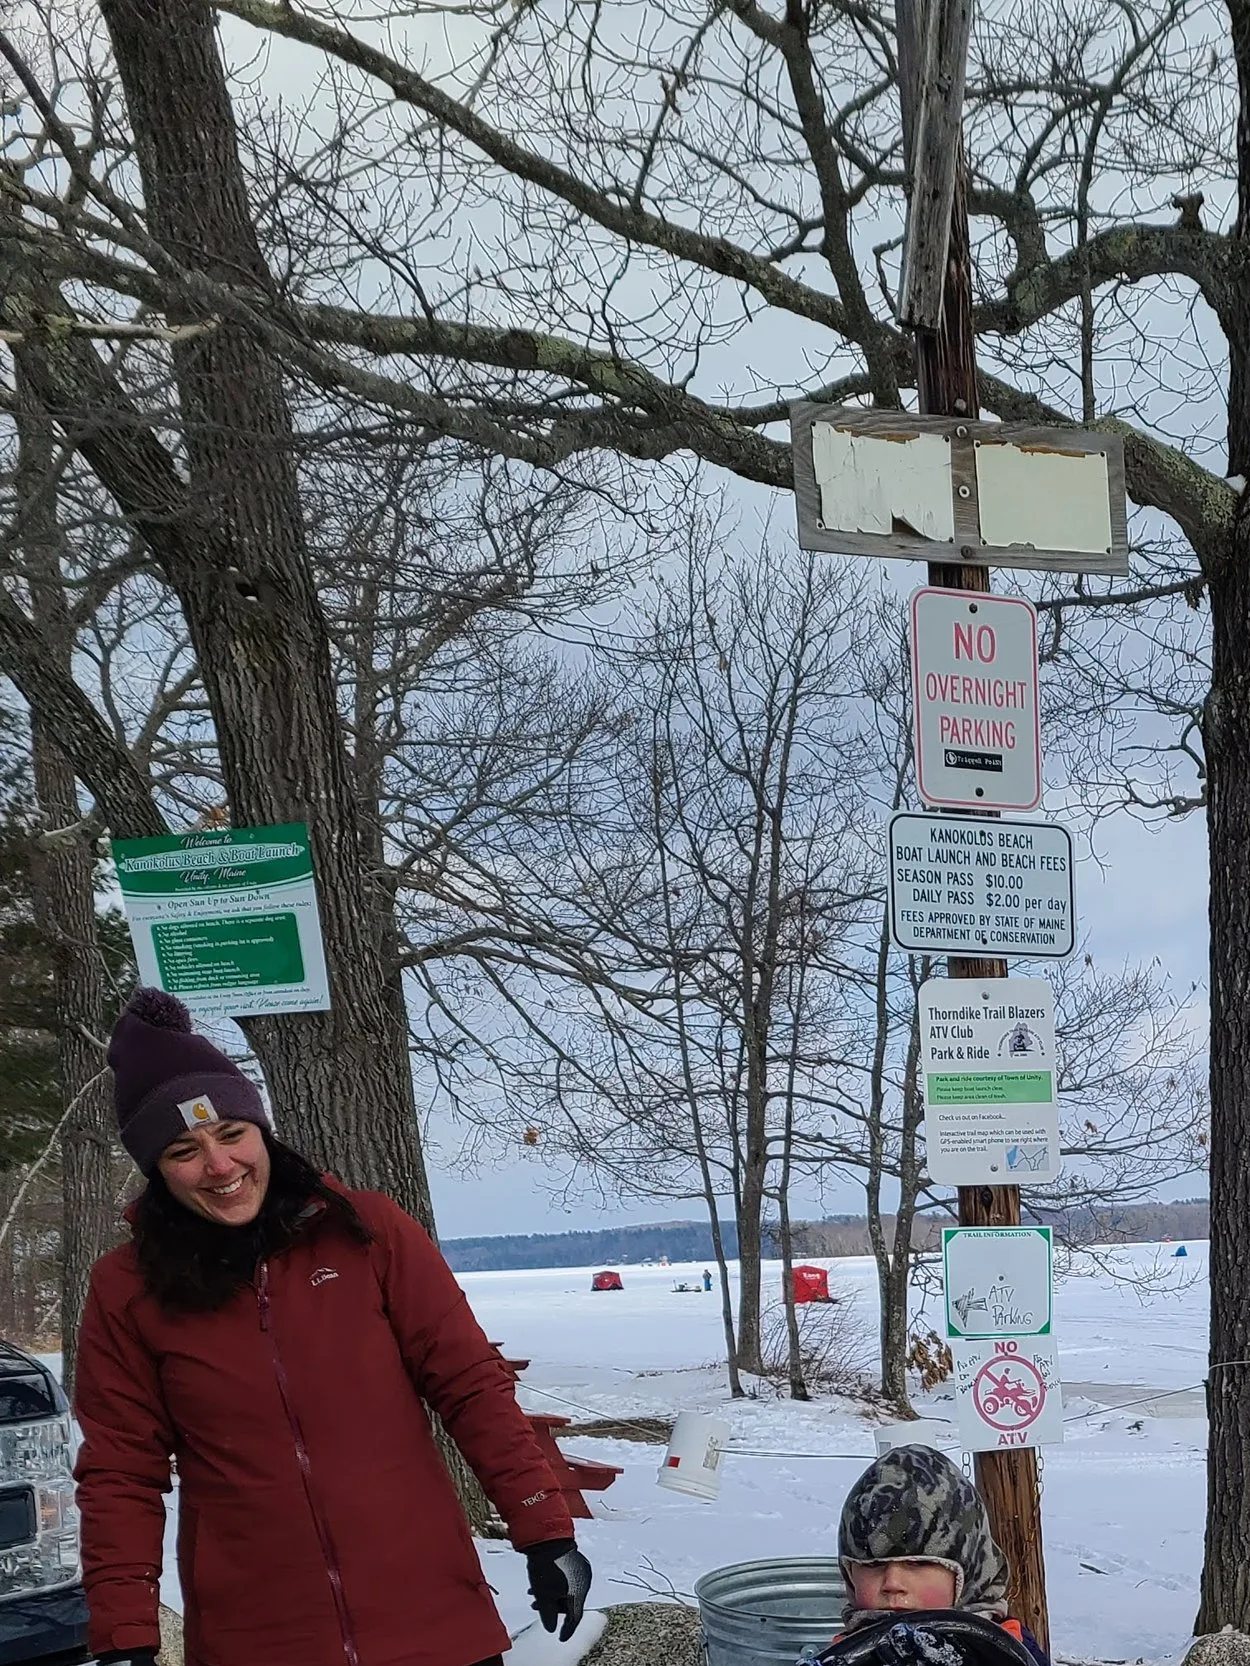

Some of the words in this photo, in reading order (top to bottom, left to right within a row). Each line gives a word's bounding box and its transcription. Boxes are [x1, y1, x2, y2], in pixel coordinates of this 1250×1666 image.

[954, 622, 996, 664] NO
[926, 672, 1027, 710] OVERNIGHT
[939, 715, 1016, 750] PARKING
[180, 835, 223, 849] Welcome
[223, 834, 233, 844] to
[930, 827, 994, 847] KANOKOLUS
[998, 833, 1033, 850] BEACH
[182, 852, 215, 867] Beach
[218, 851, 229, 864] &
[231, 848, 257, 862] Boat
[258, 843, 298, 859] Launch
[896, 846, 923, 861] BOAT
[928, 848, 971, 866] LAUNCH
[975, 852, 996, 867] AND
[1001, 853, 1036, 870] BEACH
[1040, 856, 1066, 872] FEES
[213, 867, 246, 880] Maine
[897, 868, 942, 885] SEASON
[947, 872, 974, 886] PASS
[985, 873, 1023, 890] $10.00
[168, 900, 188, 910] Open
[208, 897, 219, 906] Up
[229, 894, 245, 904] Sun
[247, 893, 270, 902] Down
[913, 888, 942, 903] DAILY
[947, 891, 974, 905] PASS
[986, 892, 1020, 908] $2.00
[1024, 899, 1042, 911] per
[1047, 897, 1067, 914] day
[901, 910, 924, 923] FEES
[928, 912, 975, 926] APPROVED
[979, 914, 991, 926] BY
[994, 915, 1020, 928] STATE
[1023, 917, 1035, 928] OF
[1038, 918, 1066, 931] MAINE
[913, 926, 971, 941] DEPARTMENT
[974, 929, 986, 941] OF
[990, 930, 1055, 945] CONSERVATION
[928, 1006, 981, 1021] Thorndike
[982, 1006, 1006, 1020] Trail
[1008, 1005, 1045, 1019] Blazers
[929, 1025, 950, 1039] ATV
[951, 1024, 974, 1039] Club
[931, 1046, 954, 1060] Park
[956, 1046, 965, 1059] &
[967, 1045, 990, 1059] Ride
[987, 1137, 1004, 1145] phone
[988, 1285, 1015, 1303] ATV
[994, 1341, 1018, 1354] NO
[998, 1432, 1028, 1446] ATV
